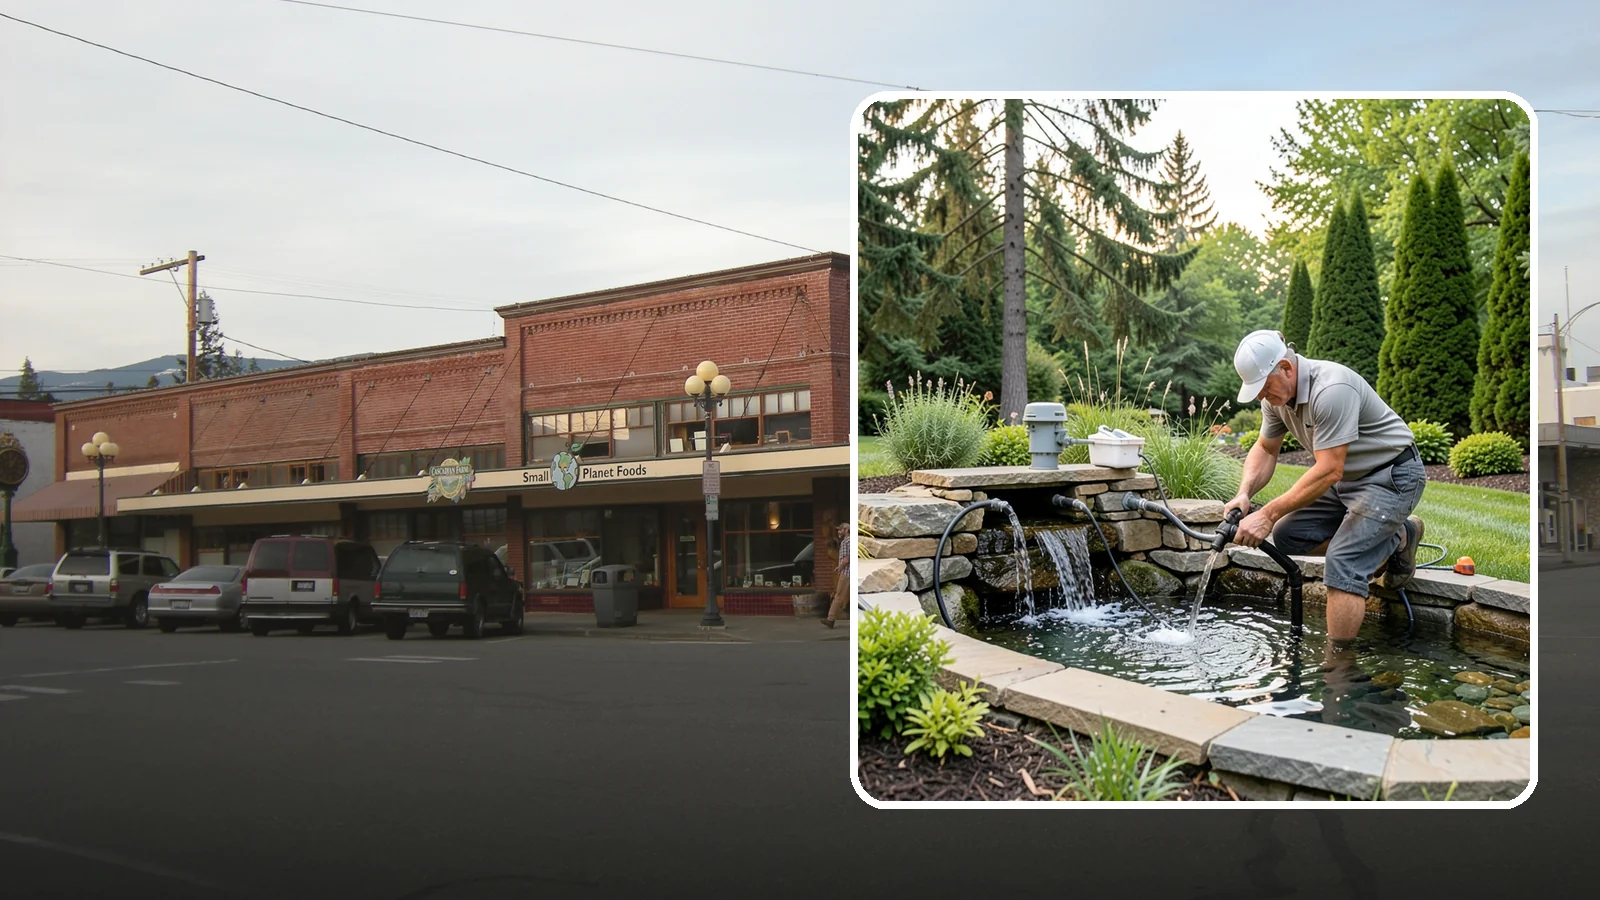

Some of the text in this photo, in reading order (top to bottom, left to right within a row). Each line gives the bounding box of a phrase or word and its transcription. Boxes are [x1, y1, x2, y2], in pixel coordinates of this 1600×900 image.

[523, 464, 646, 482] Small Planet Foods
